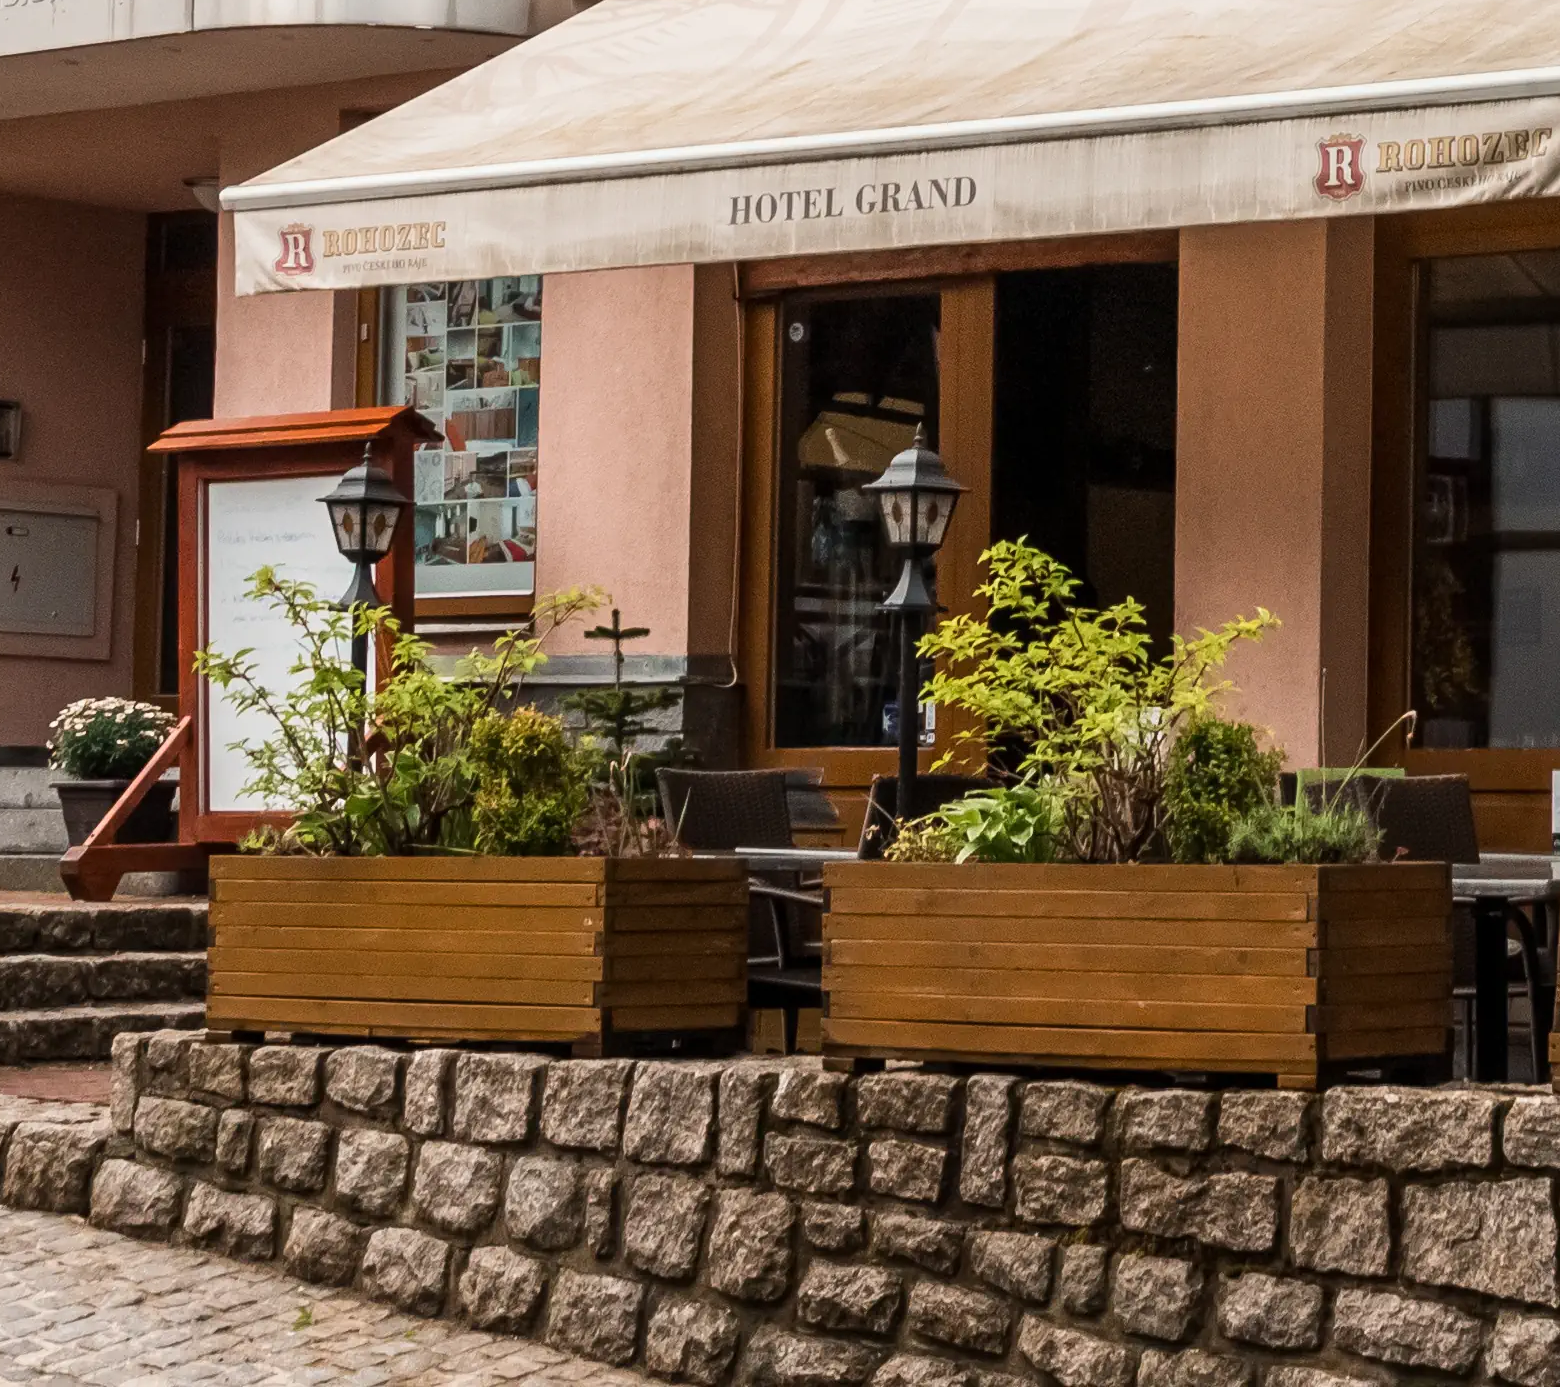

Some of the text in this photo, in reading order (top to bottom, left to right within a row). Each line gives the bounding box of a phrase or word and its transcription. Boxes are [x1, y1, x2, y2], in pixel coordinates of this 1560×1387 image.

[1324, 128, 1553, 188] R ROHOZEC
[728, 175, 978, 227] HOTEL GRAND
[1405, 179, 1435, 193] PIVO
[322, 221, 448, 258] ROHOZEC
